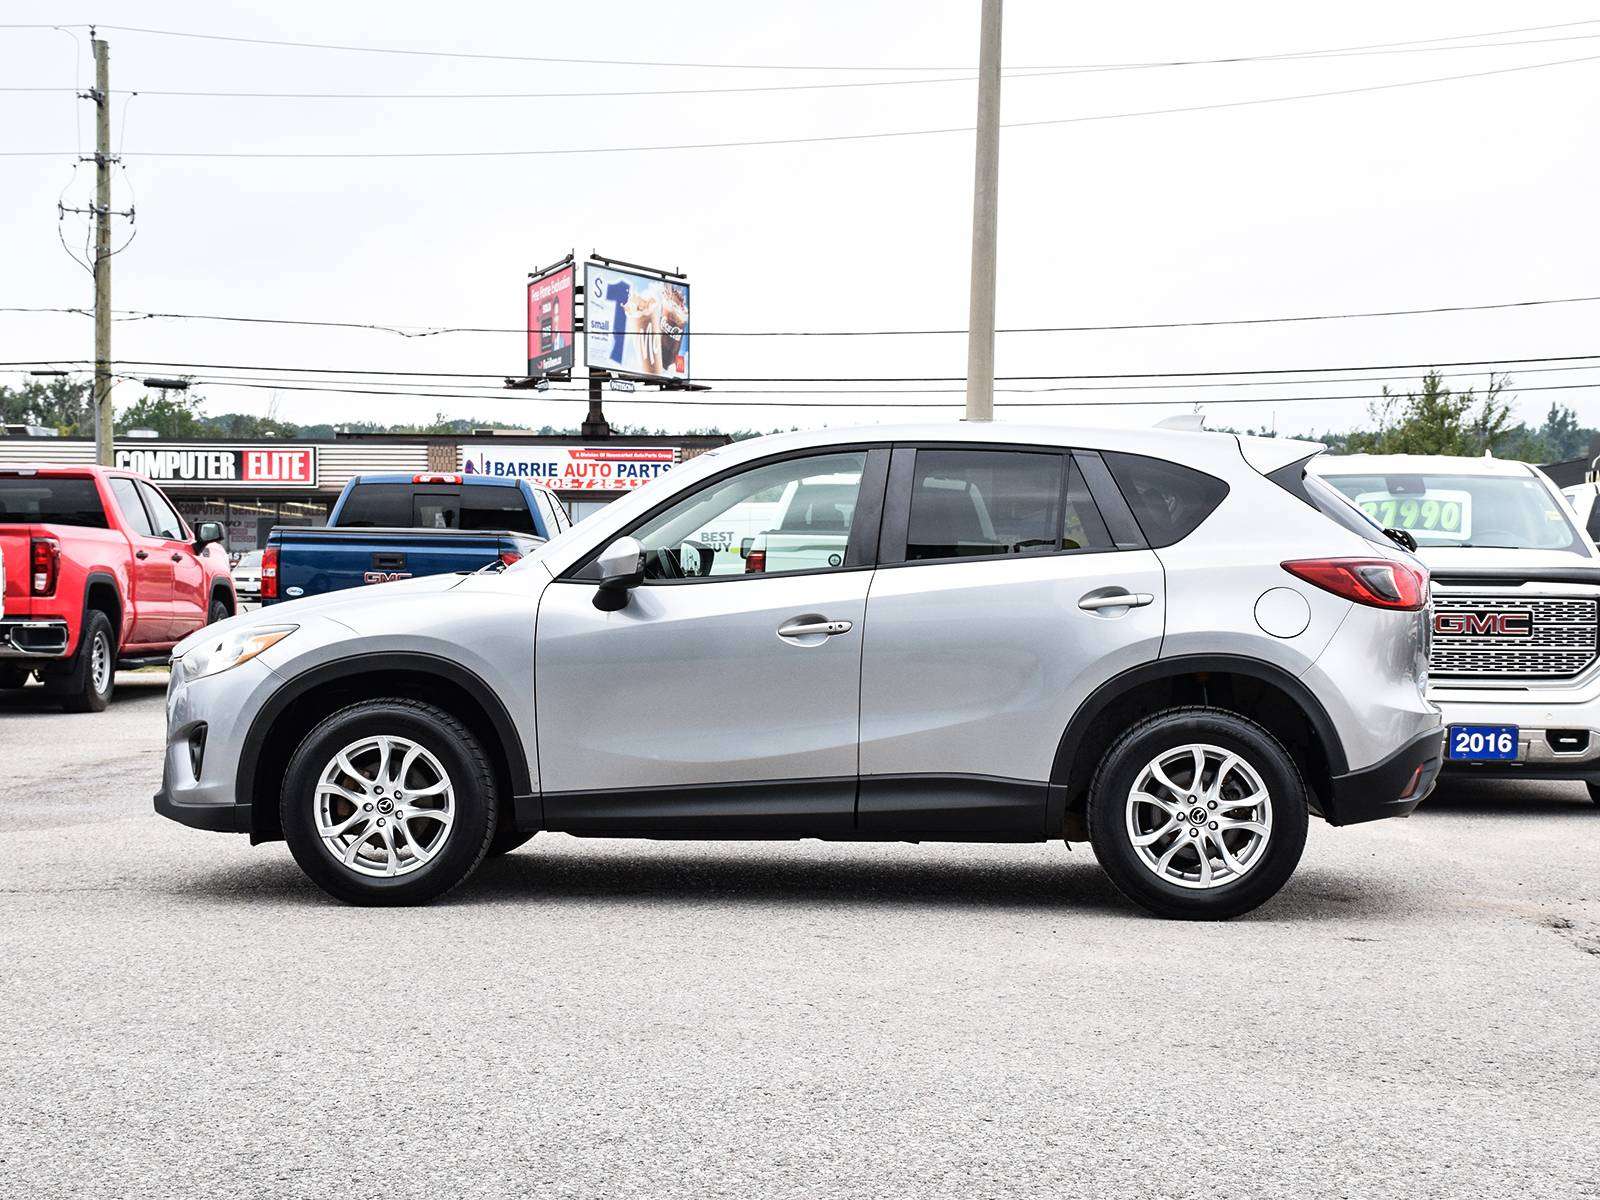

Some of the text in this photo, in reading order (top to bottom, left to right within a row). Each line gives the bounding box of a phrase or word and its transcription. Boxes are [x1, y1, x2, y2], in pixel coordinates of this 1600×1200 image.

[590, 320, 610, 331] small
[115, 450, 305, 480] COMPUTER ELITE
[494, 462, 672, 478] BARRIE AUTO PARTS
[701, 532, 734, 542] BEST
[704, 542, 732, 552] UY
[1434, 612, 1530, 635] GMC
[1455, 732, 1513, 753] 2016
